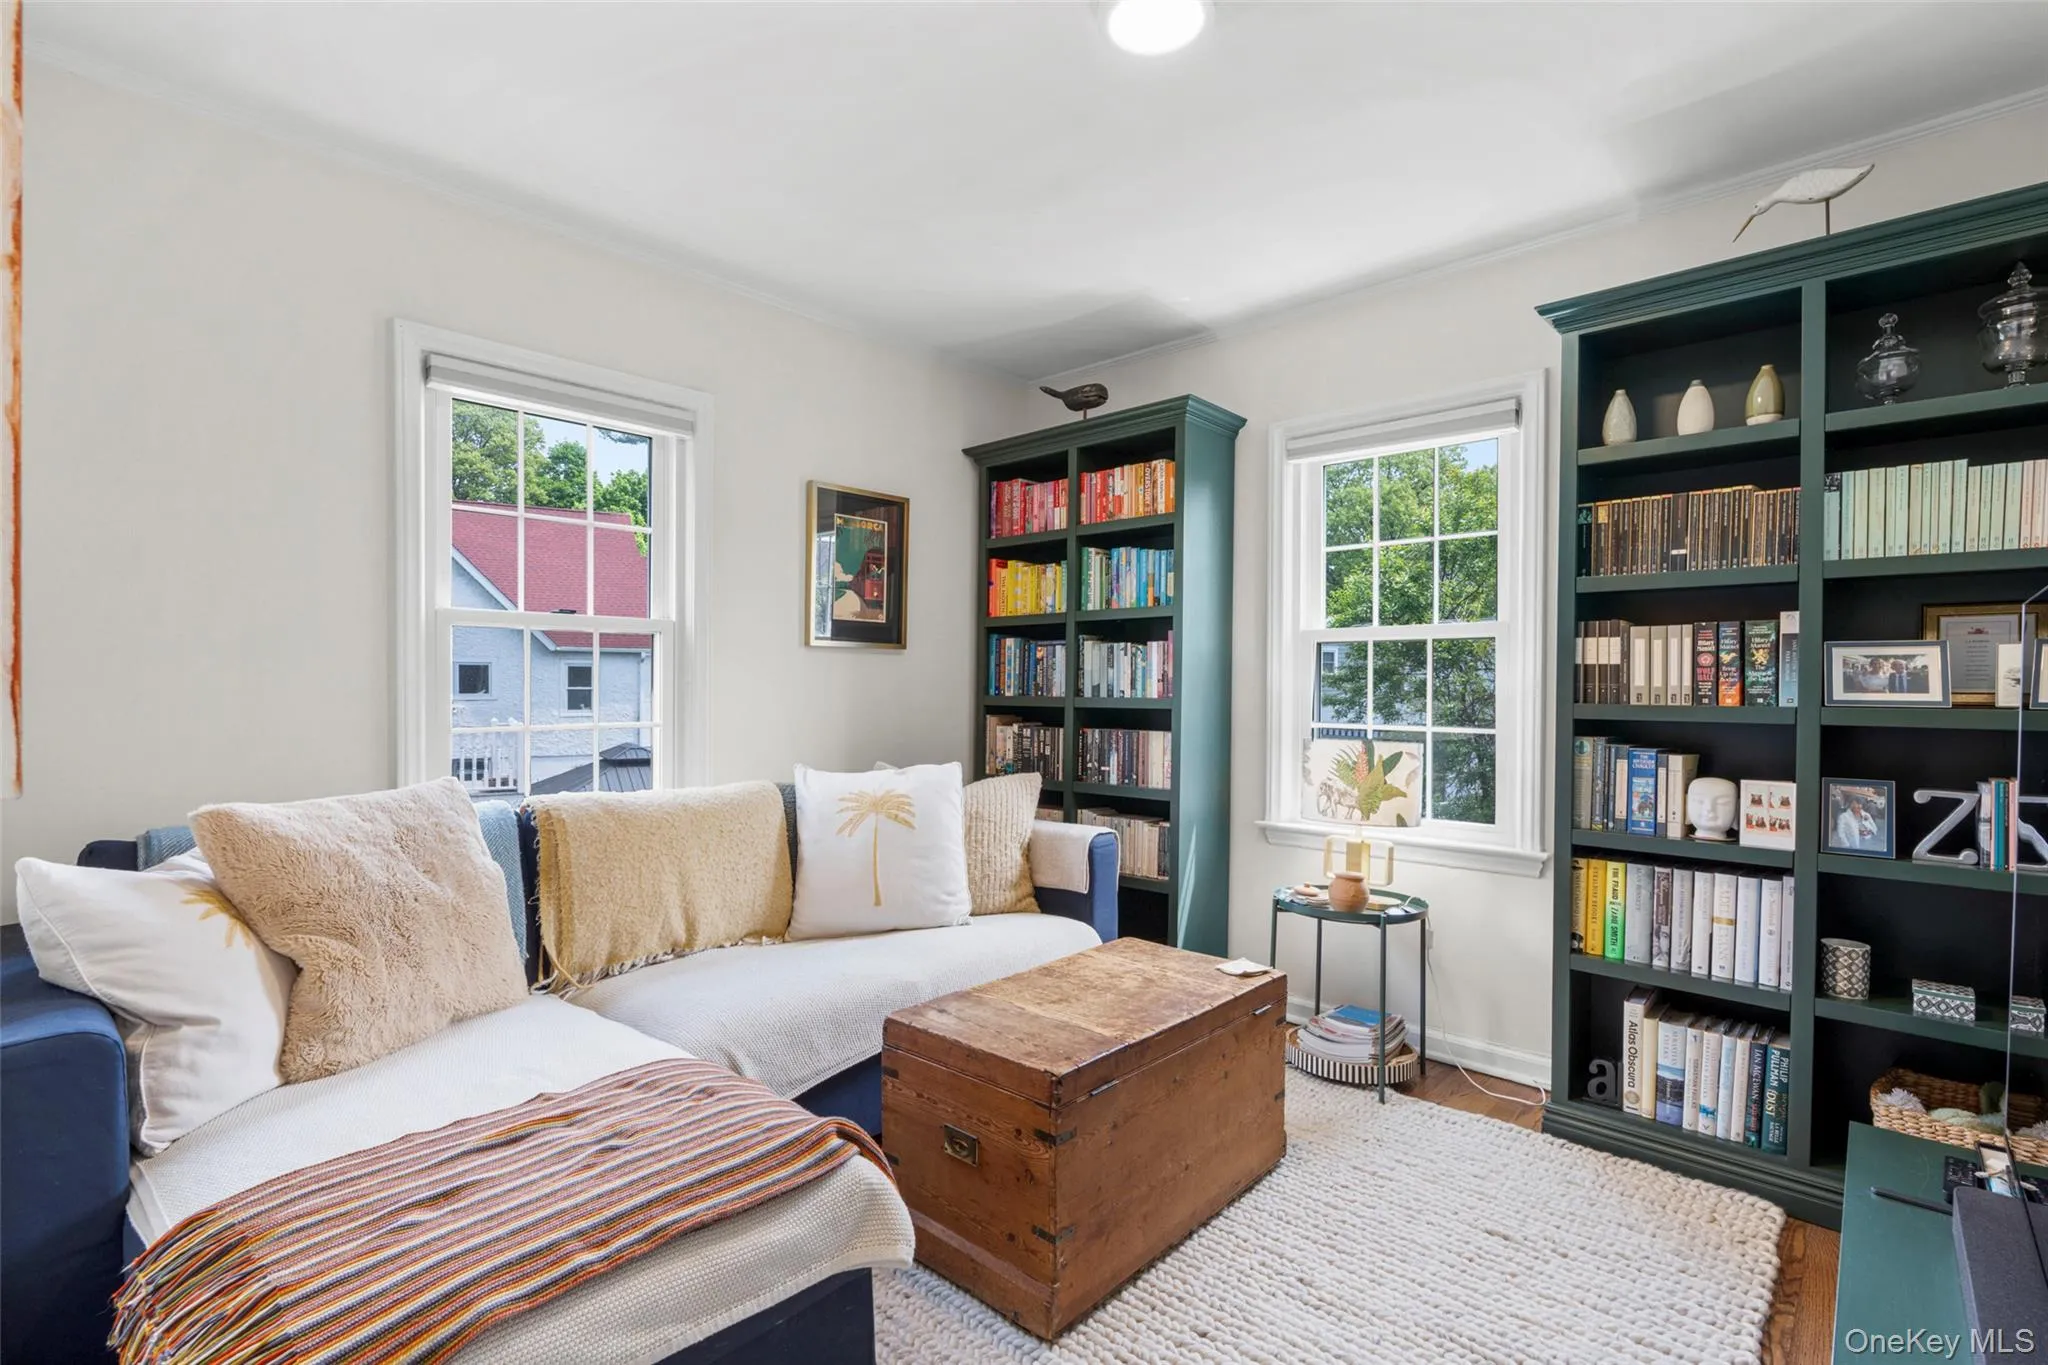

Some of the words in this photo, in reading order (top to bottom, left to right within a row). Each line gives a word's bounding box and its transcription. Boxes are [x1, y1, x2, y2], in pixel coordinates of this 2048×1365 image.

[1610, 926, 1618, 946] SMITH
[1628, 1020, 1639, 1046] Atlas
[1627, 1046, 1638, 1088] Obscura
[1754, 1049, 1764, 1063] IAN
[1770, 1049, 1780, 1087] PULLMAN
[1779, 1057, 1789, 1083] PHILIP
[1765, 1091, 1777, 1118] DUST
